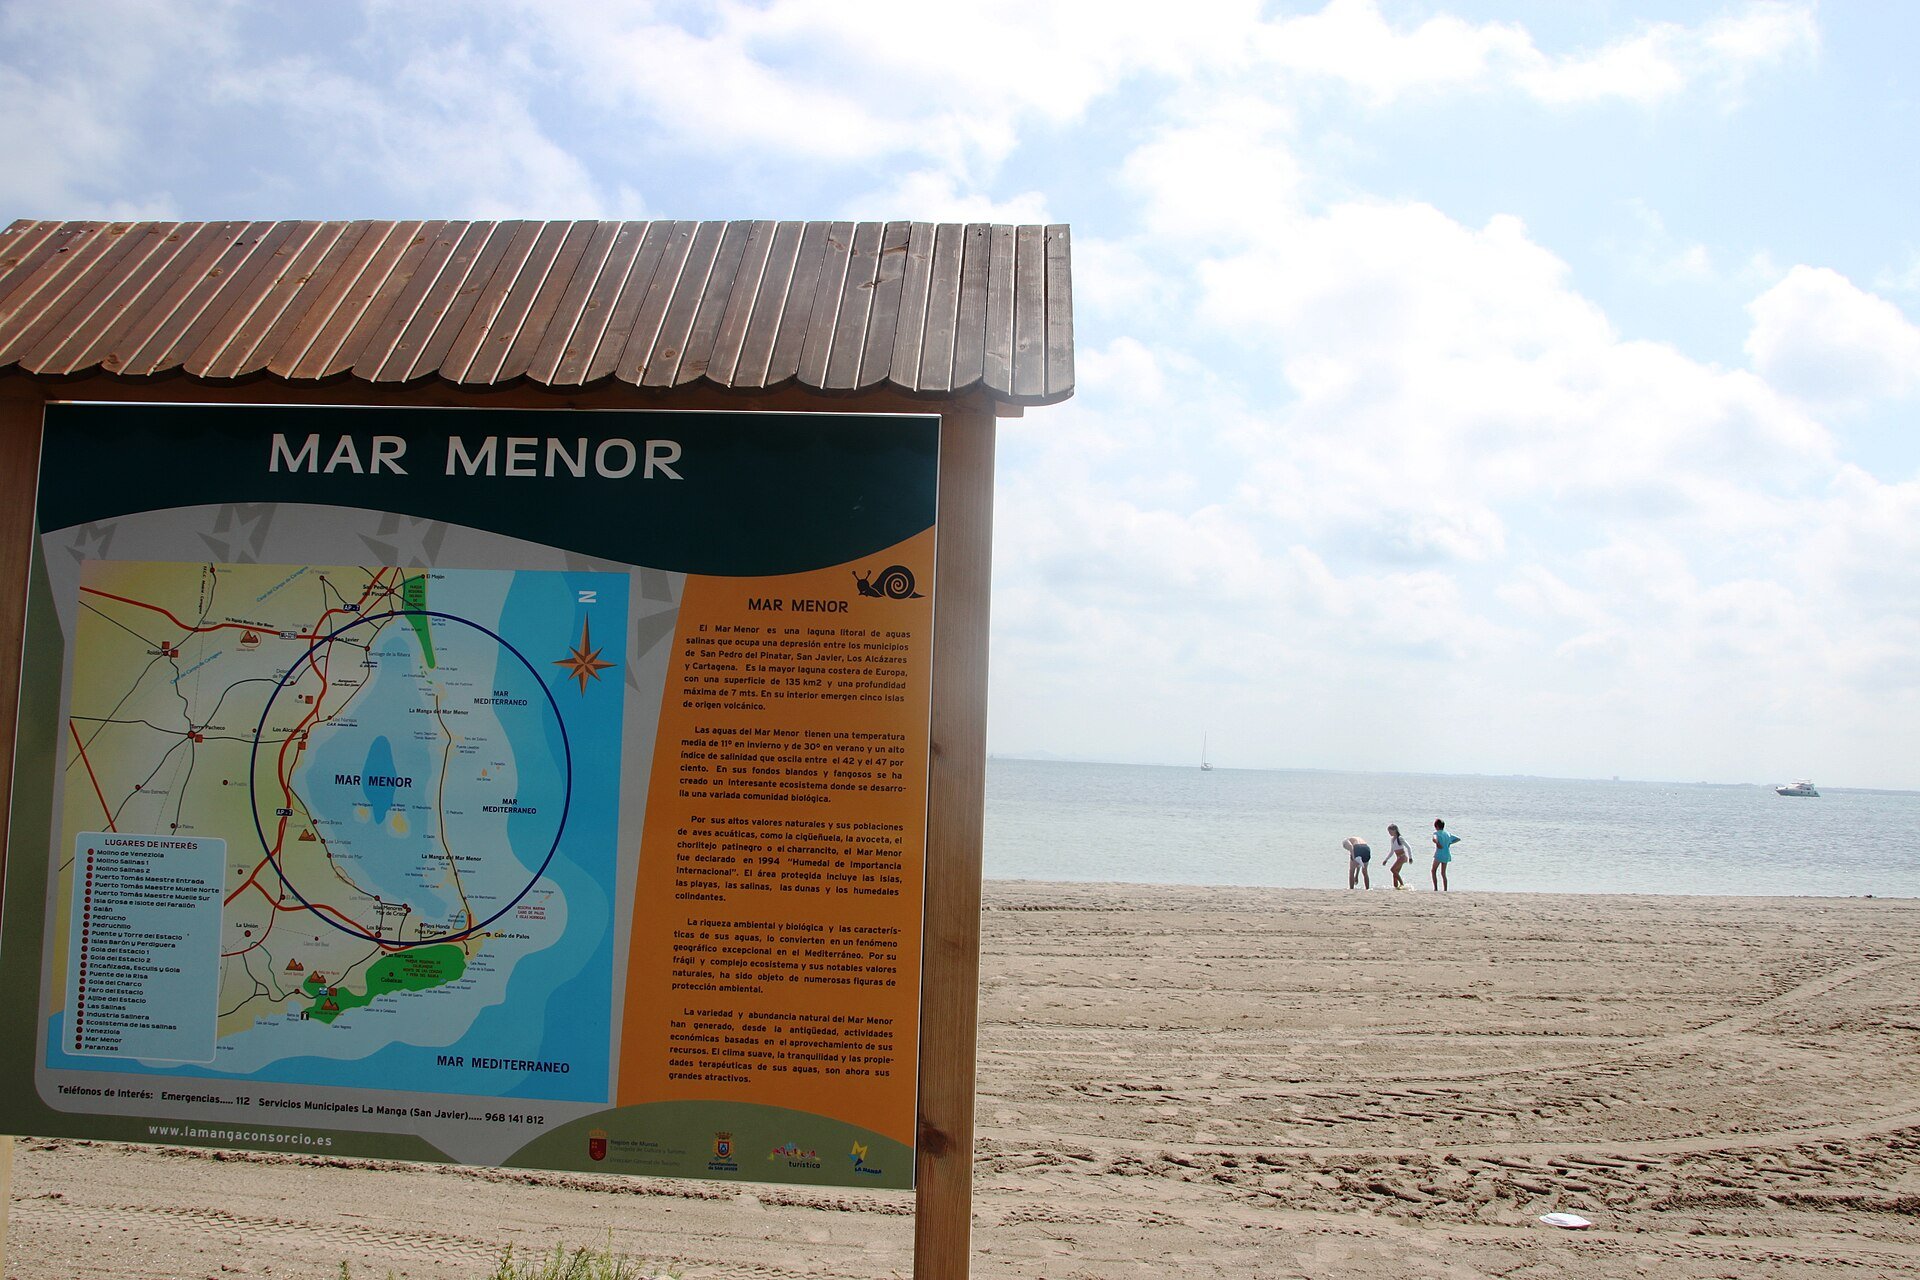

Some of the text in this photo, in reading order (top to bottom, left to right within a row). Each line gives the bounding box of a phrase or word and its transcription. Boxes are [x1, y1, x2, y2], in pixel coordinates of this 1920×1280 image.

[268, 433, 684, 480] MAR MENOR
[748, 598, 848, 613] MAR MENOR
[699, 624, 707, 632] El
[715, 624, 731, 632] Mar
[733, 625, 760, 633] Menor
[807, 627, 835, 636] laguna
[840, 628, 865, 636] litoral
[870, 629, 880, 637] de
[885, 631, 910, 639] aguas
[686, 636, 715, 644] salinas
[734, 639, 759, 647] ocupa
[779, 639, 821, 648] depresión
[848, 641, 860, 649] los
[863, 642, 908, 652] municipios
[685, 649, 907, 663] de San Pedro del Pinatar, San Javier, Los Alcázares
[473, 697, 527, 706] MEDITERRANEO
[694, 700, 721, 710] origen
[723, 701, 765, 710] volcánico.
[694, 726, 709, 734] Las
[711, 727, 737, 736] aguas
[739, 727, 752, 735] del
[754, 728, 770, 736] Mar
[773, 728, 799, 737] Menor
[804, 729, 831, 738] tienen
[851, 731, 905, 741] temperatura
[334, 774, 412, 788] MAR MENOR
[679, 789, 689, 797] lla
[709, 790, 740, 799] variada
[742, 792, 788, 801] comunidad
[790, 793, 831, 804] biológica.
[482, 805, 536, 814] MEDITERRANEO
[690, 815, 706, 823] Por
[727, 817, 749, 825] altos
[751, 818, 782, 826] valores
[784, 819, 825, 828] naturales
[828, 822, 833, 830] y
[853, 822, 903, 831] poblaciones
[105, 839, 197, 849] LUGARES DE INTERÉS
[744, 868, 752, 876] El
[757, 868, 776, 878] área
[781, 871, 821, 880] protegida
[826, 872, 857, 882] incluye
[862, 874, 875, 882] las
[879, 874, 902, 884] islas,
[674, 892, 726, 901] colindantes.
[687, 918, 697, 926] La
[699, 918, 731, 927] riqueza
[733, 920, 775, 929] ambiental
[778, 923, 783, 931] y
[785, 922, 823, 932] biológica
[838, 924, 851, 932] las
[853, 926, 901, 934] caracterís-
[671, 982, 763, 993] protección ambiental.
[86, 1019, 128, 1027] Ecosistema
[684, 1007, 694, 1015] La
[696, 1009, 733, 1017] variedad
[748, 1011, 796, 1020] abundancia
[798, 1014, 830, 1022] natural
[832, 1015, 844, 1023] del
[847, 1015, 864, 1023] Mar
[866, 1016, 893, 1025] Menor
[85, 1027, 120, 1035] Veneziola
[670, 1019, 893, 1038] han generado, desde la antigüedad, actividades
[436, 1055, 569, 1073] MAR MEDITERRANEO
[668, 1072, 751, 1082] grandes atractivos.
[57, 1085, 101, 1096] Teléfonos
[104, 1088, 115, 1096] de
[117, 1088, 153, 1099] Interés:
[236, 1096, 250, 1105] 112
[258, 1097, 301, 1108] Servicios
[304, 1100, 358, 1113] Municipales
[362, 1104, 373, 1113] La
[376, 1105, 407, 1117] Manga
[409, 1108, 431, 1117] (San
[485, 1112, 505, 1122] 968
[508, 1114, 523, 1123] 141
[526, 1115, 544, 1124] 812
[148, 1125, 331, 1146] www.lamangaconsorcio.es
[788, 1160, 820, 1168] turístico
